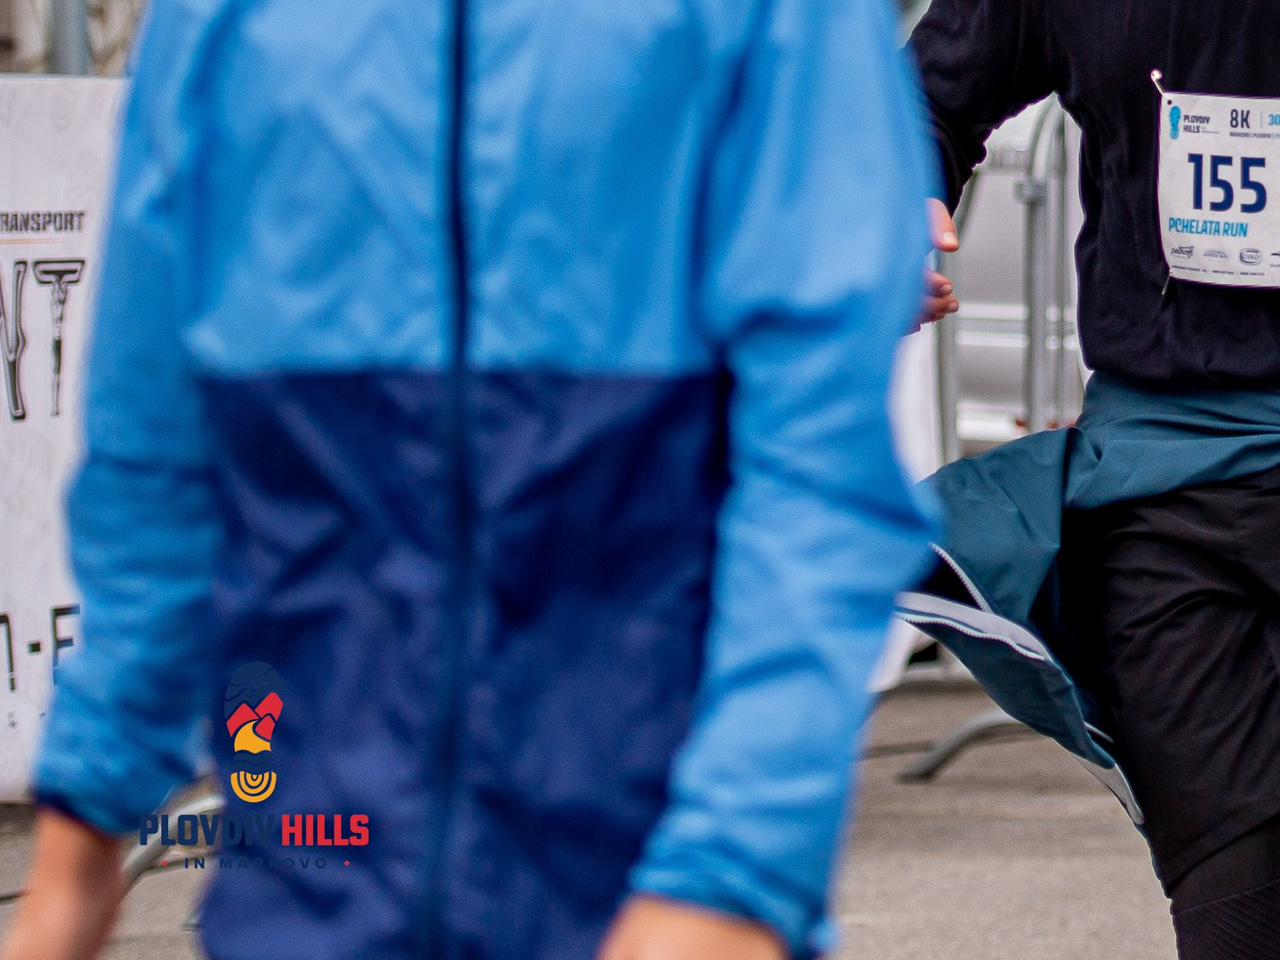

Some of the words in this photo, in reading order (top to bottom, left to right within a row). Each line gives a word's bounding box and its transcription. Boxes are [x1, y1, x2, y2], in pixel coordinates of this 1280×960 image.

[1183, 115, 1210, 125] PLOVDIV
[1229, 109, 1251, 129] 8K
[1183, 125, 1201, 134] HILLS
[1187, 153, 1268, 214] 155
[1168, 217, 1221, 236] PCHELATA
[1222, 222, 1249, 238] RUN
